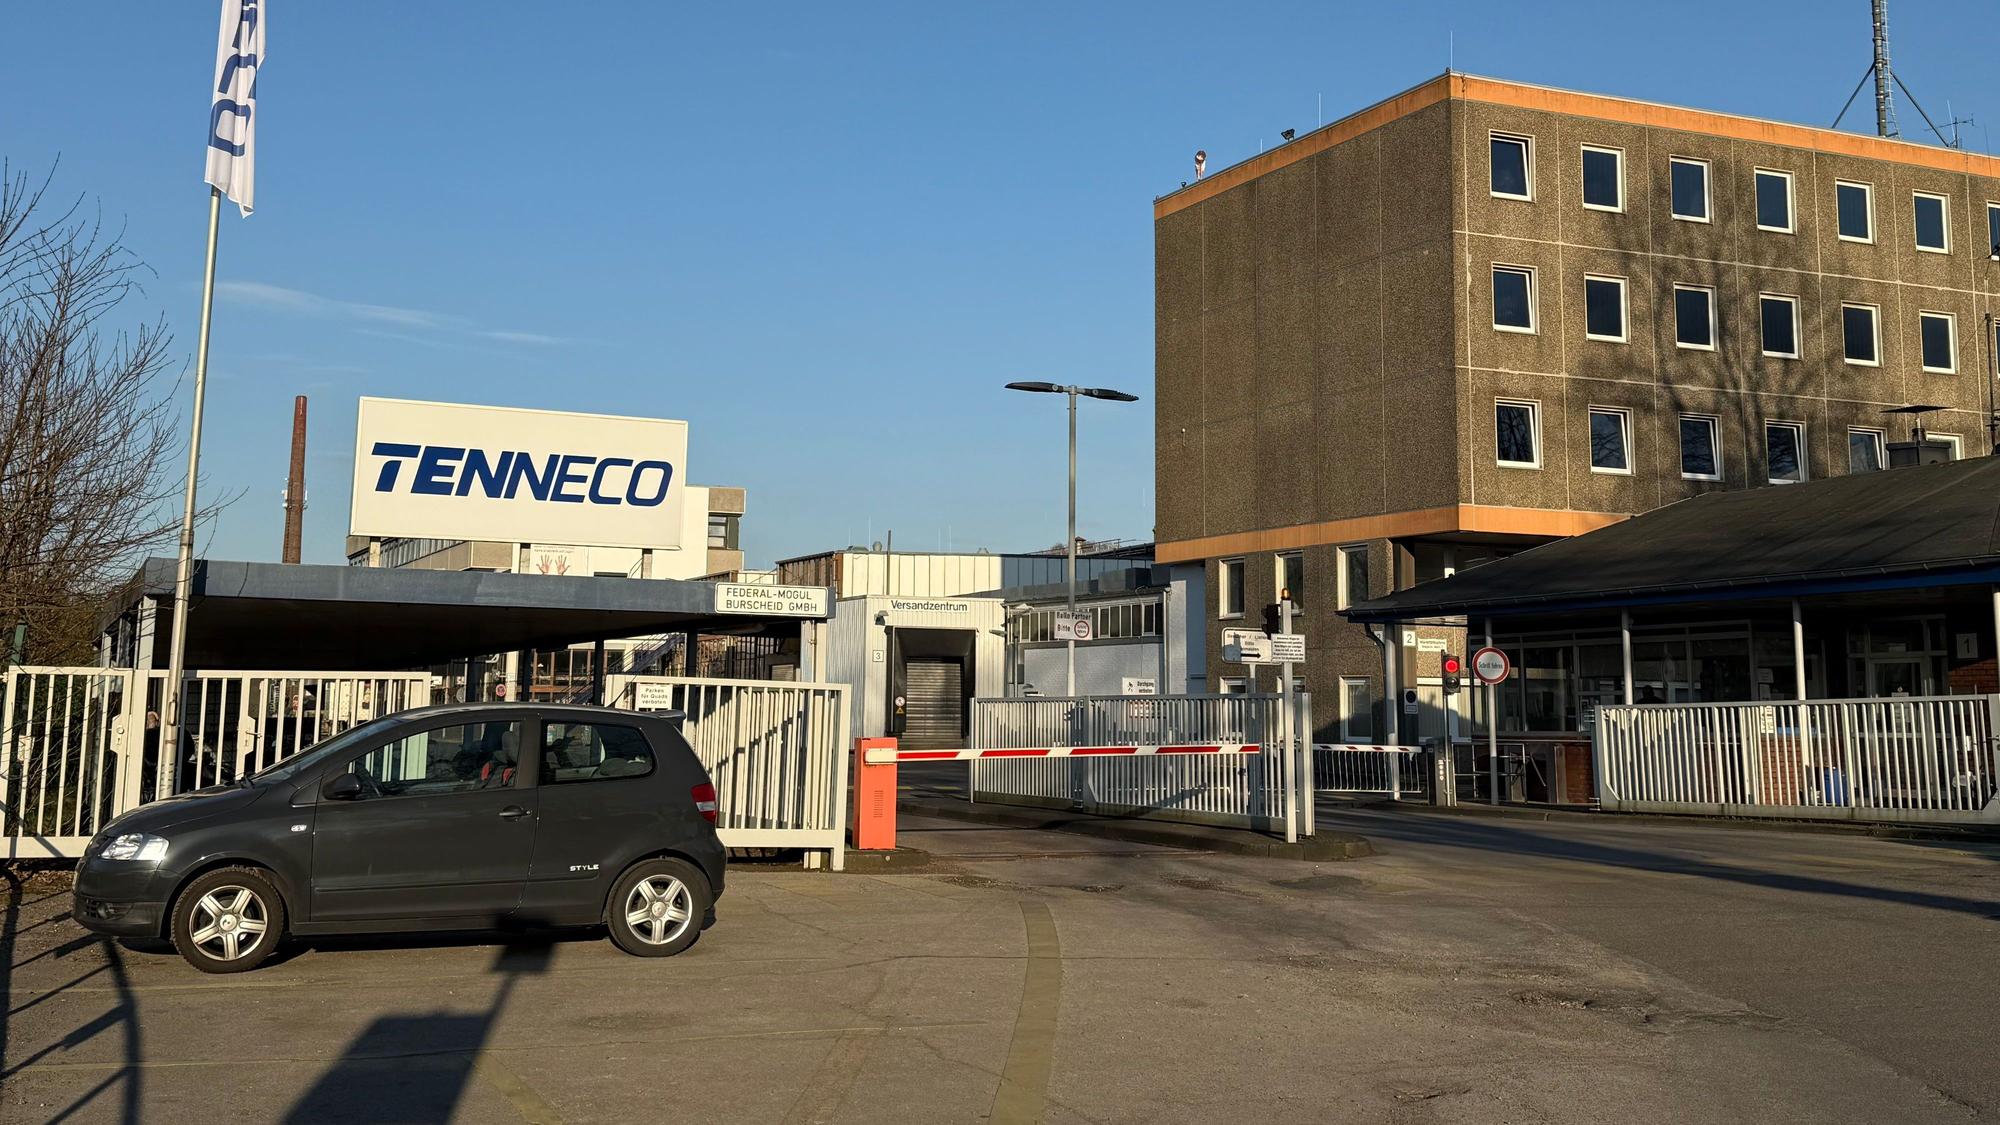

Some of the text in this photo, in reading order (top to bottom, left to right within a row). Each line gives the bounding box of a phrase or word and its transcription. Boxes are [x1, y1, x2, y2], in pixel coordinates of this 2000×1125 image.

[371, 442, 674, 507] TENNECO
[726, 587, 812, 600] FEDERAL-MOGUL
[726, 600, 817, 612] BURSCHEID GMBH
[891, 600, 968, 611] Versandzentrum
[1071, 612, 1091, 620] Partner
[1057, 624, 1071, 632] Bitte
[1406, 633, 1412, 643] 2
[875, 652, 881, 660] 3
